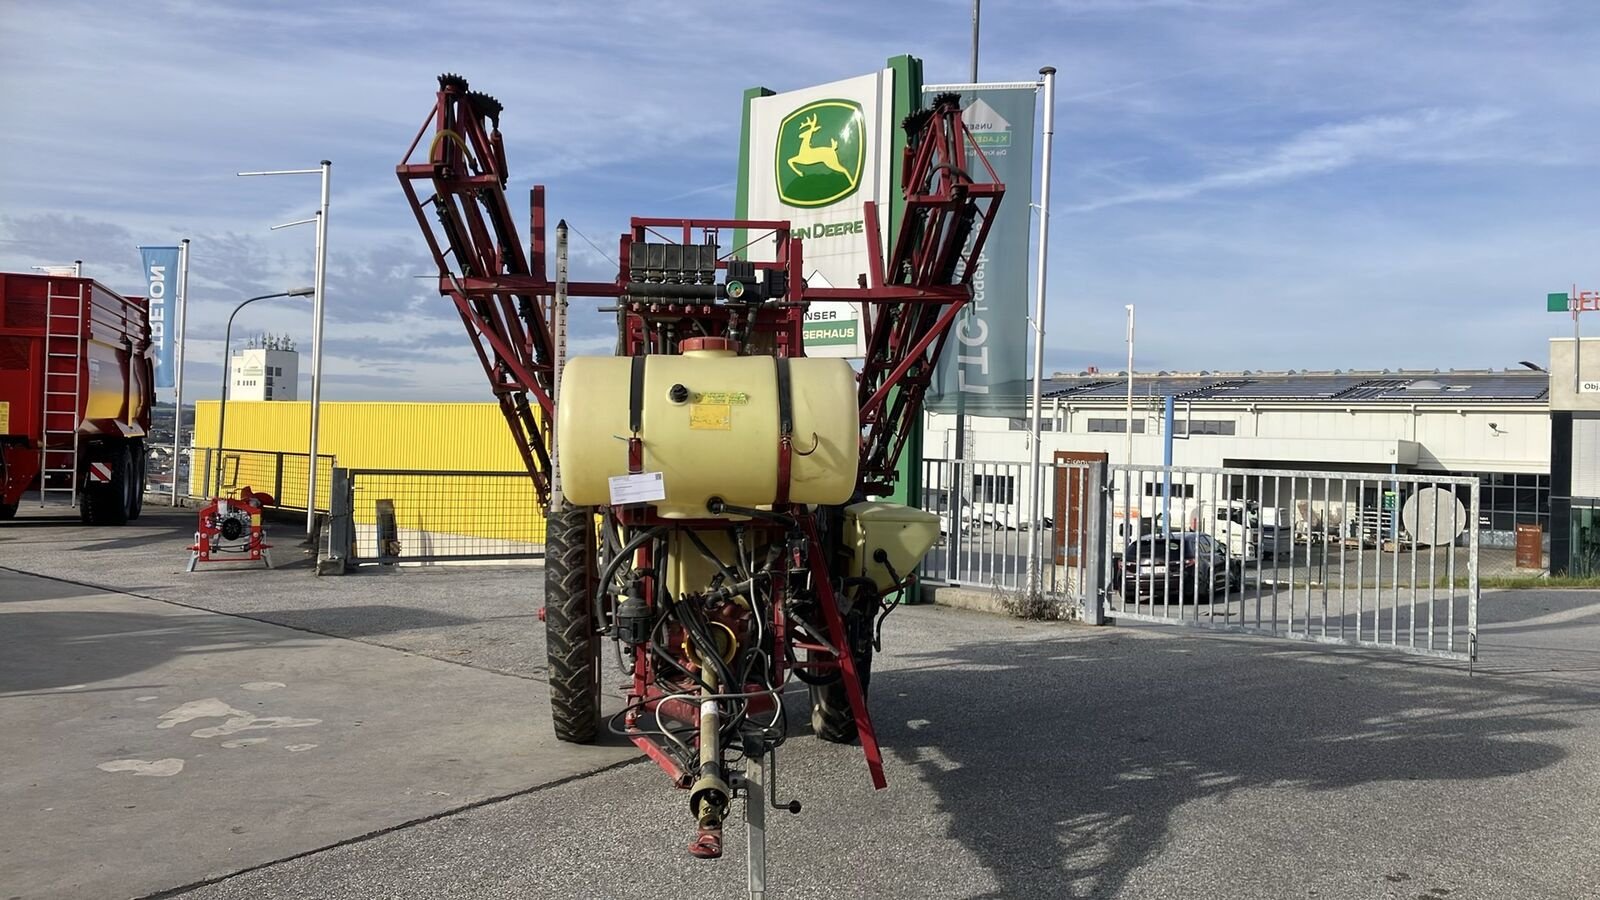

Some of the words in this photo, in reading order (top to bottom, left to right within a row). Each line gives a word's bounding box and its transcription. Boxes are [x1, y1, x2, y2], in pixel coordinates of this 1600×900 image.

[813, 220, 864, 239] DEERE
[805, 310, 837, 321] NSER
[803, 327, 855, 340] GERHAUS
